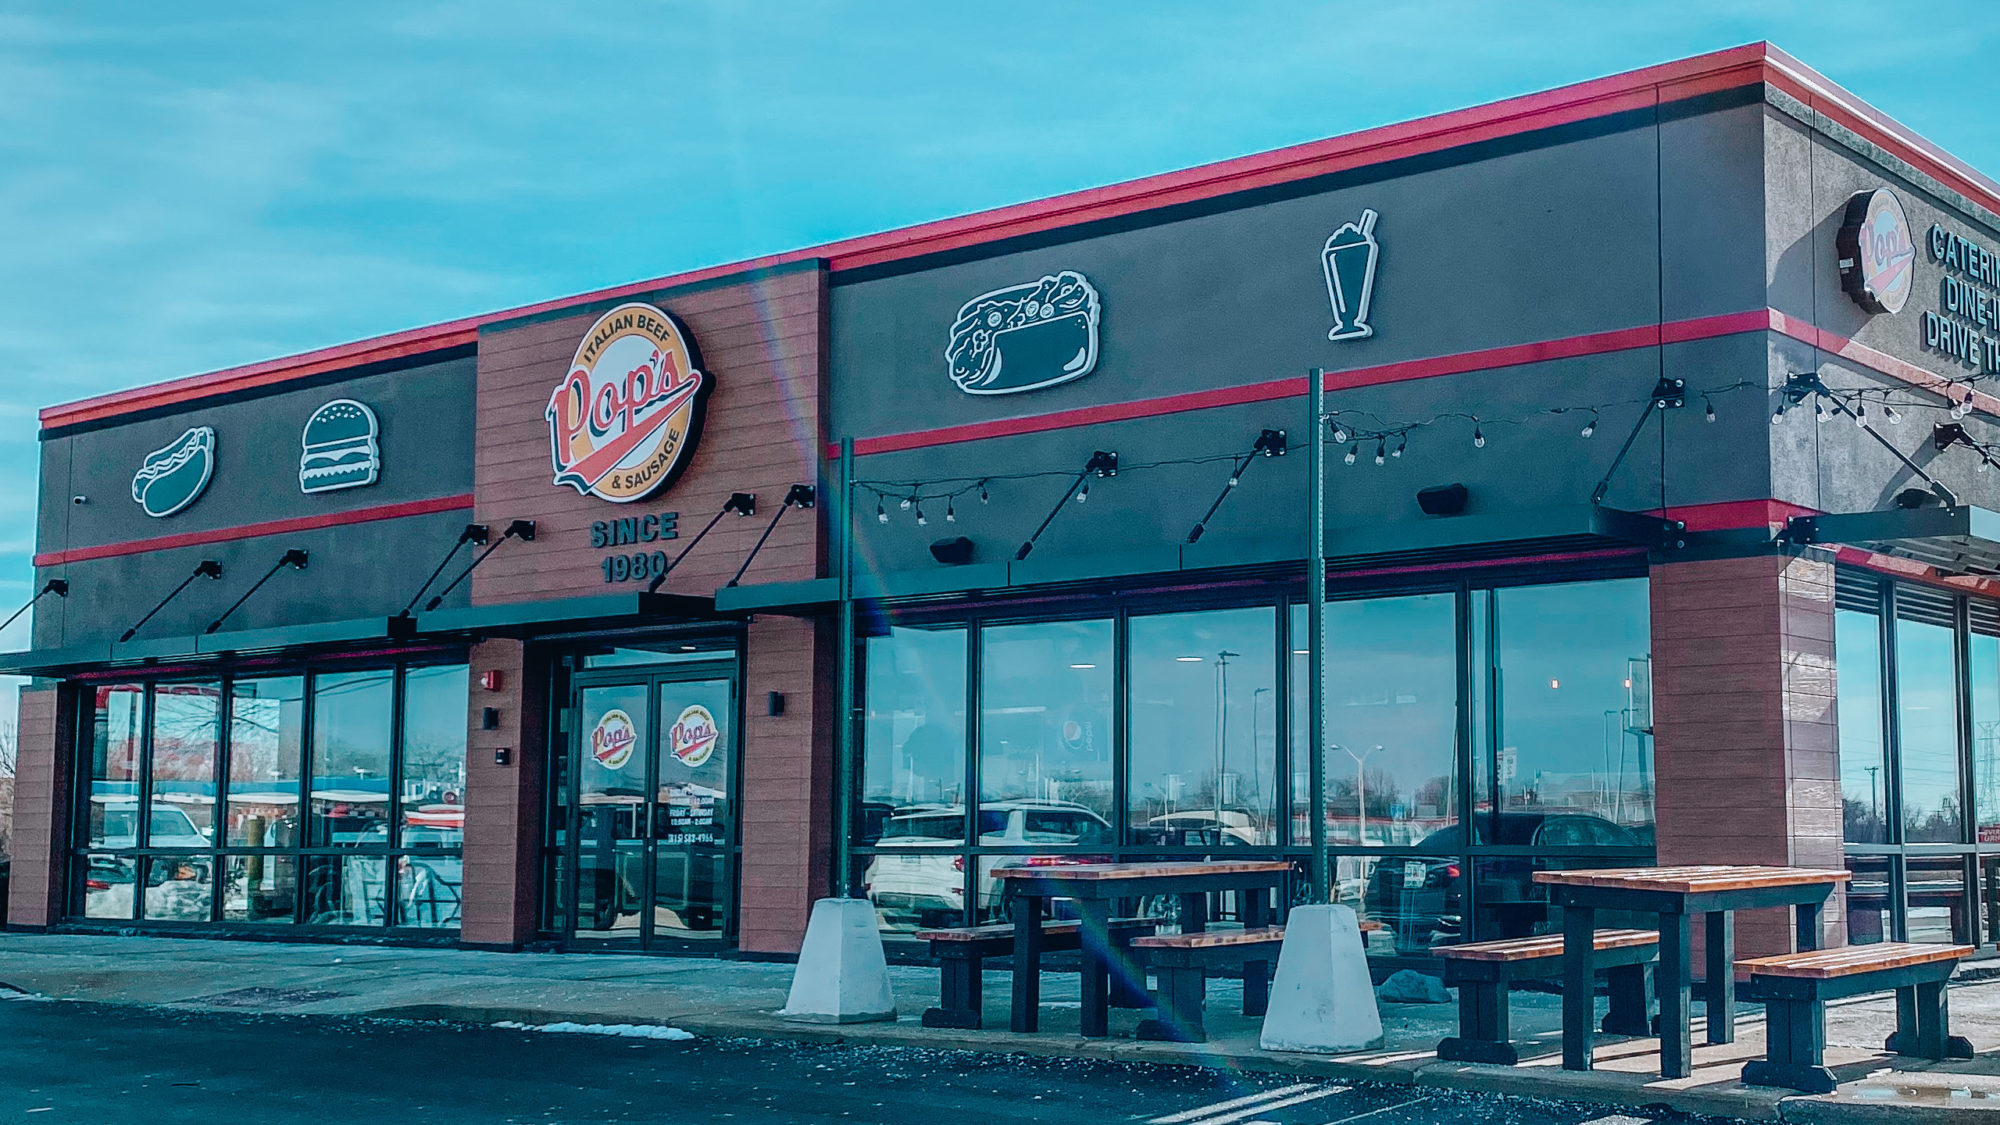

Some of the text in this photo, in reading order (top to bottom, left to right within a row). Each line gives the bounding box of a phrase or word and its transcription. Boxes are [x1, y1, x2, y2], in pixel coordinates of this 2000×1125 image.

[1946, 275, 2000, 332] DINE-I
[583, 314, 670, 363] ITALIAN BEEF
[1926, 311, 1980, 365] DRIVE
[551, 349, 684, 466] Pop's
[611, 428, 679, 489] & SAUSAGE
[591, 512, 679, 548] SINCE
[601, 551, 667, 583] 1980
[592, 726, 631, 756] Pop's
[671, 722, 711, 753] Pop's
